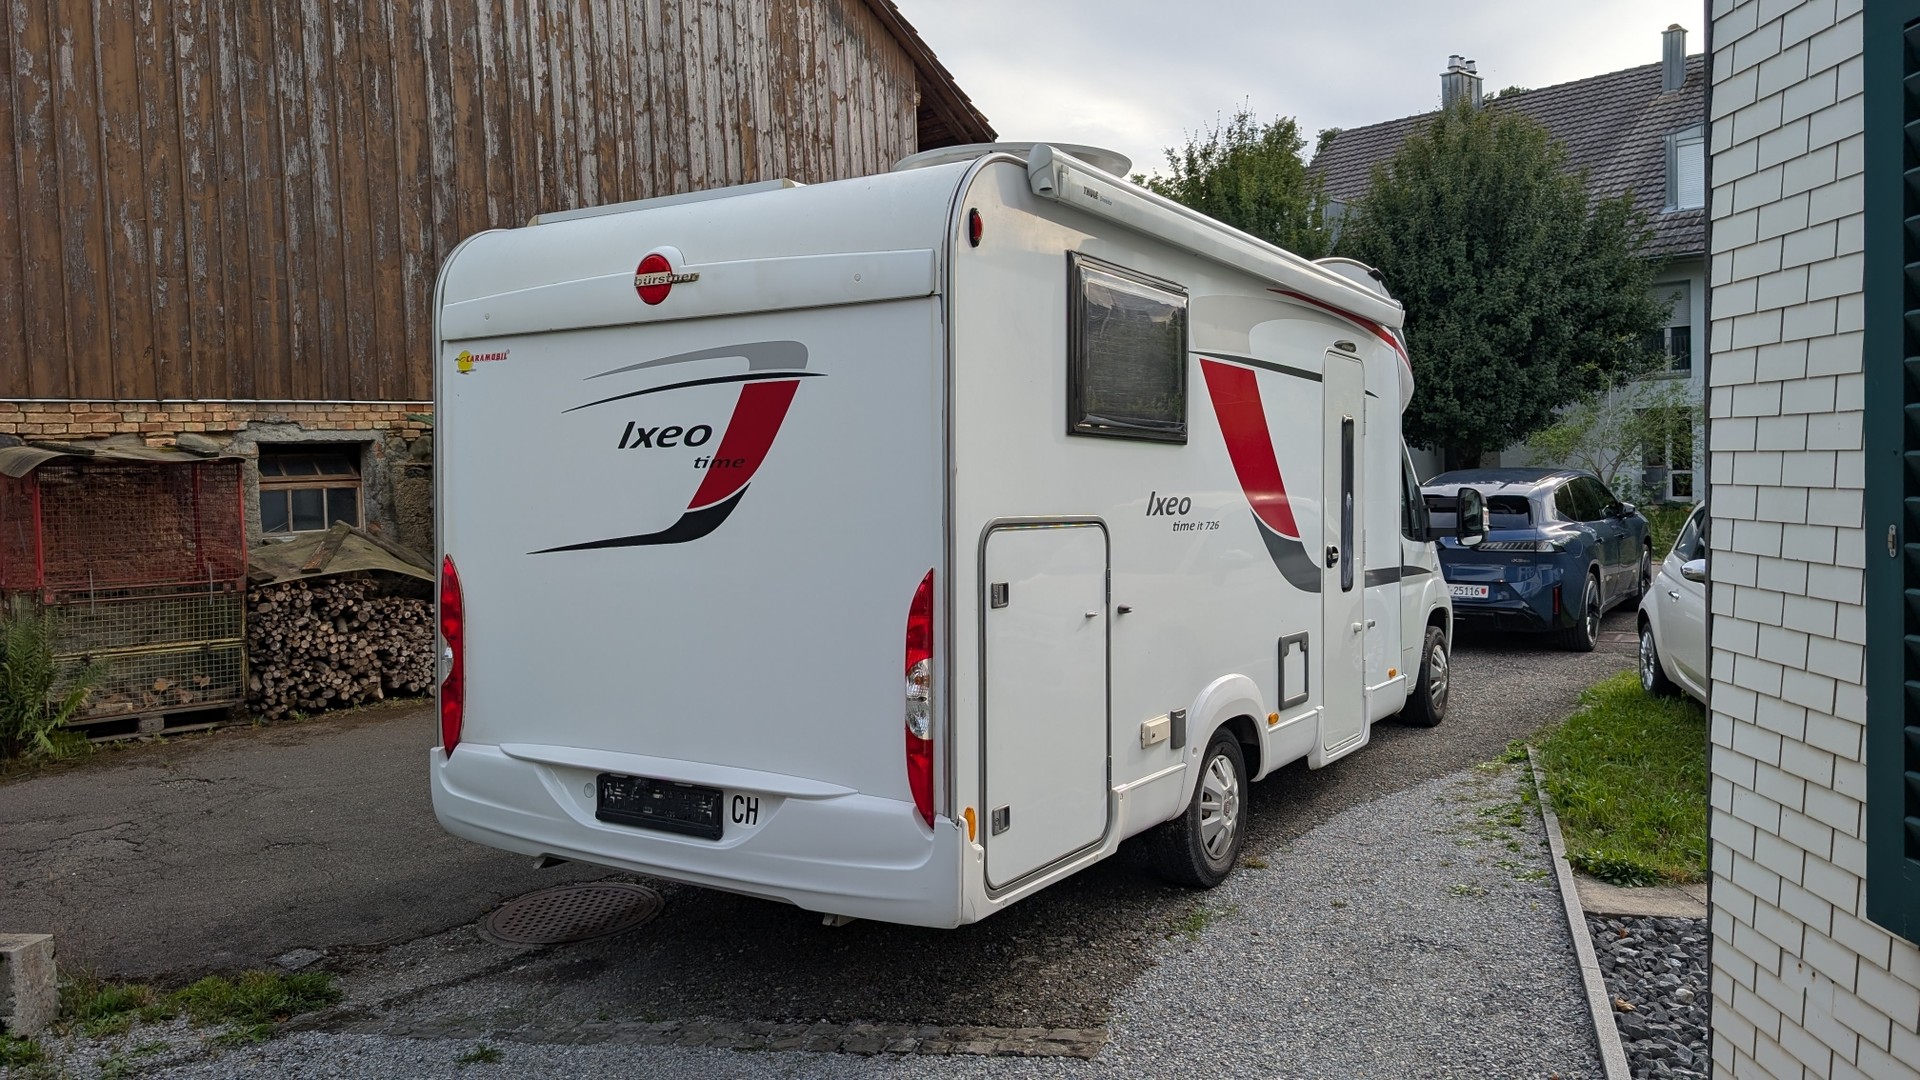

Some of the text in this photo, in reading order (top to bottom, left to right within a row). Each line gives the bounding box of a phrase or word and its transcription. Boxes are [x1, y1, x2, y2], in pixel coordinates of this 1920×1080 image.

[634, 272, 700, 287] bürstner
[466, 352, 508, 363] CARAMOBIL
[617, 421, 713, 449] Ixeo
[694, 456, 746, 469] time
[1146, 491, 1192, 516] Ixeo
[1172, 520, 1220, 532] time it 726
[731, 794, 759, 826] CH
